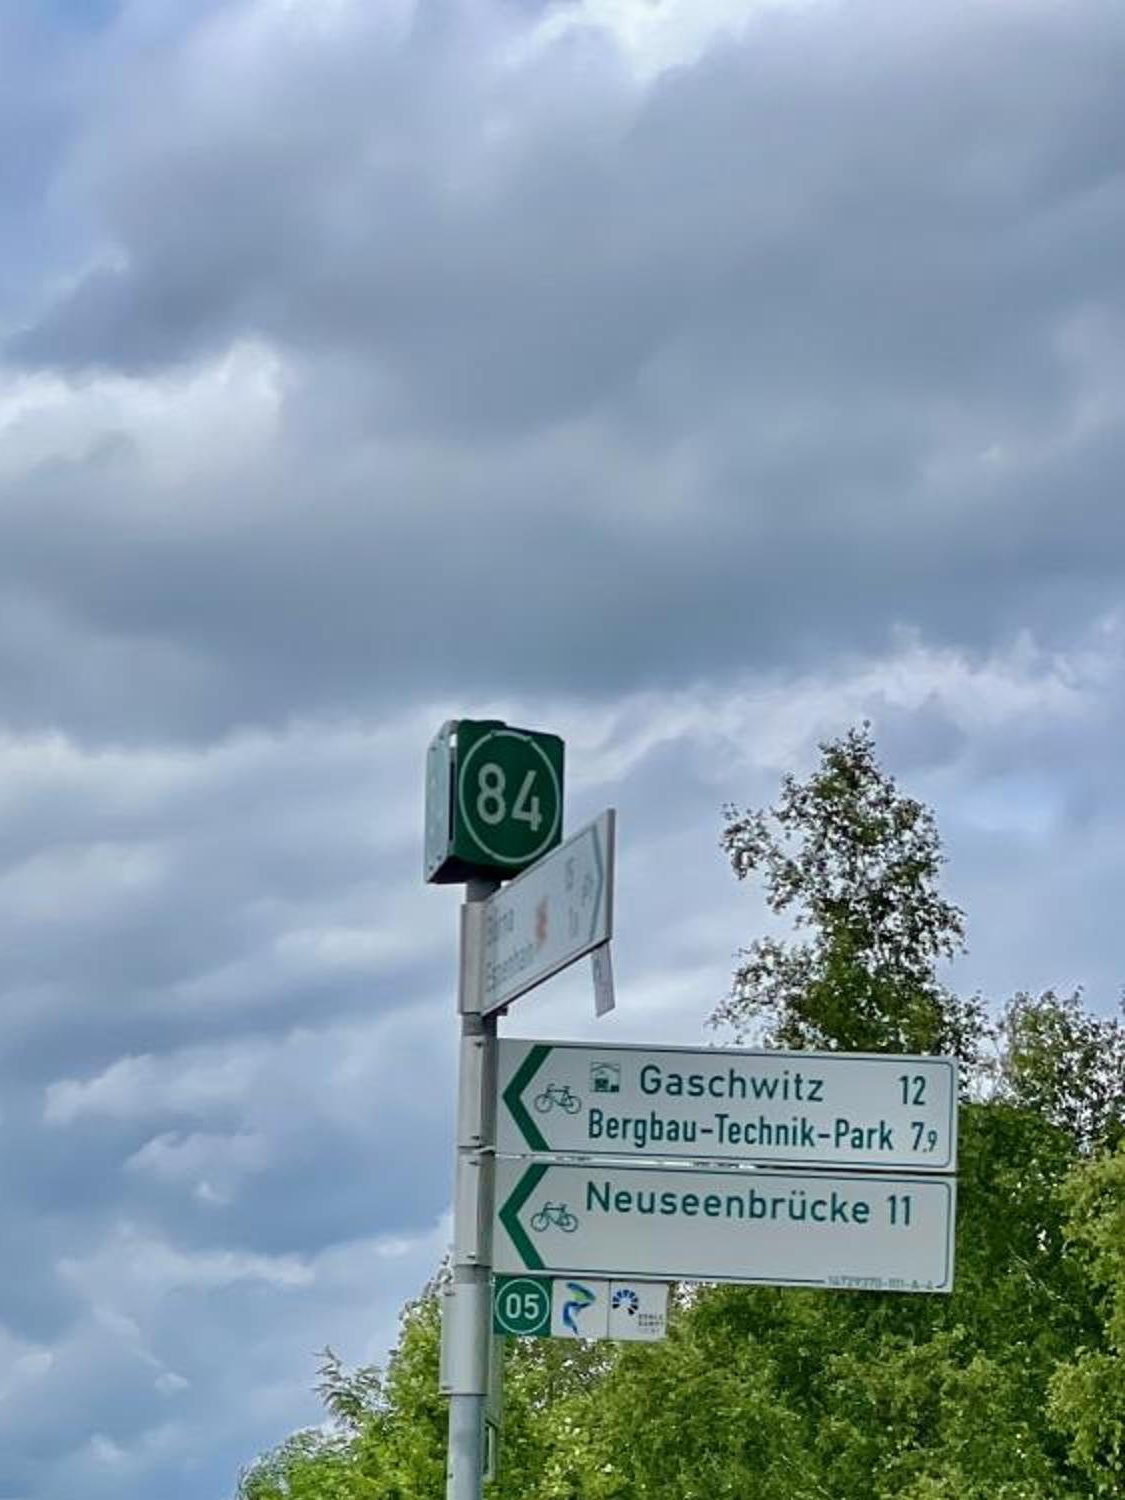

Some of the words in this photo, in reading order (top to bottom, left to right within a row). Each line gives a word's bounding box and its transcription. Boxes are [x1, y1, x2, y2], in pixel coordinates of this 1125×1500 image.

[477, 762, 541, 831] 84
[640, 1064, 824, 1103] Gaschwitz
[899, 1076, 926, 1105] 12
[588, 1109, 893, 1151] Bergbau-Technik-Park
[586, 1181, 870, 1225] Neuseenbrücke
[887, 1195, 911, 1225] 11
[506, 1293, 539, 1320] 05
